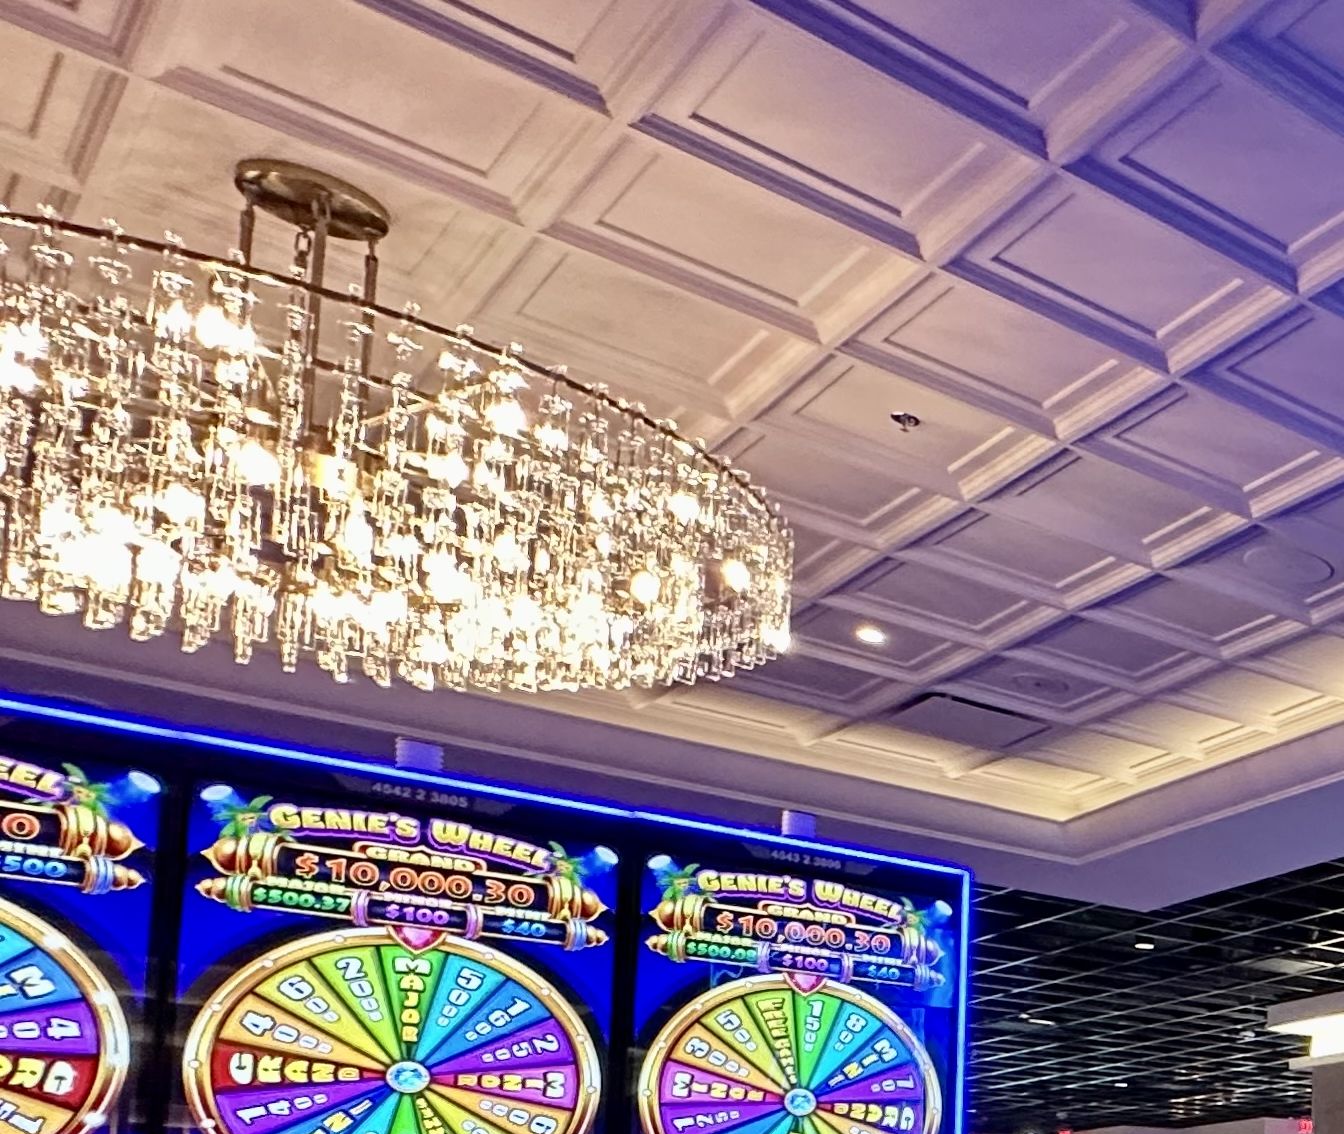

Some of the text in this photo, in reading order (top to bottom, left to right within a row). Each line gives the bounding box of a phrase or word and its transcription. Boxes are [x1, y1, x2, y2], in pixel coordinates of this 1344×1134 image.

[267, 803, 551, 870] GENIE'S WHEEL
[364, 846, 476, 873] GRAND
[294, 852, 536, 907] $10,000.30
[697, 869, 903, 918] GENIE'S WHEEL
[252, 887, 351, 913] $500.37
[384, 904, 451, 925] $100
[766, 905, 849, 924] GRAND
[501, 919, 547, 937] $40
[715, 911, 892, 955] $10,000.30
[781, 953, 829, 971] $100
[867, 964, 901, 980] $40
[393, 957, 432, 1043] MAJOR
[228, 1052, 361, 1085] GRAND
[826, 1037, 899, 1088] MINI
[456, 1071, 566, 1099] MINOR
[671, 1070, 766, 1102] MINOR
[832, 1102, 916, 1132] GRAND
